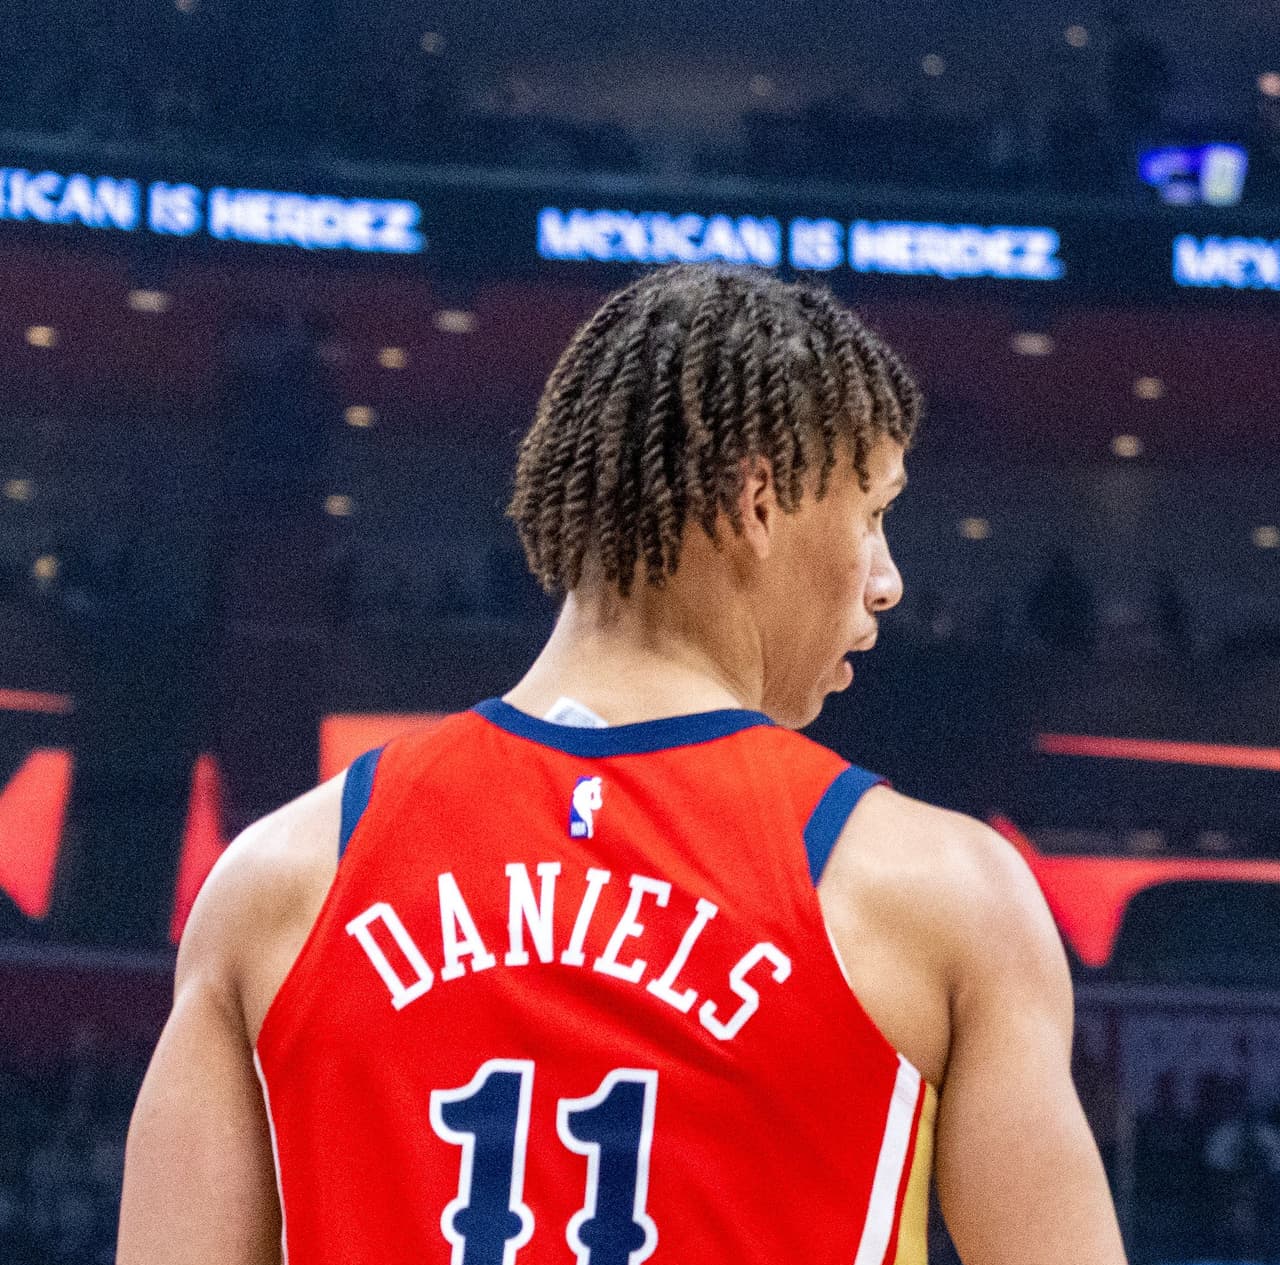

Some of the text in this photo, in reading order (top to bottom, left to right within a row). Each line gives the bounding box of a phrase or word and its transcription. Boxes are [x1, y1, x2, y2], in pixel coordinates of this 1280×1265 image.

[0, 168, 142, 231] ICAN
[148, 181, 202, 236] IS
[790, 216, 843, 270] IS
[345, 862, 792, 1041] DANIELS
